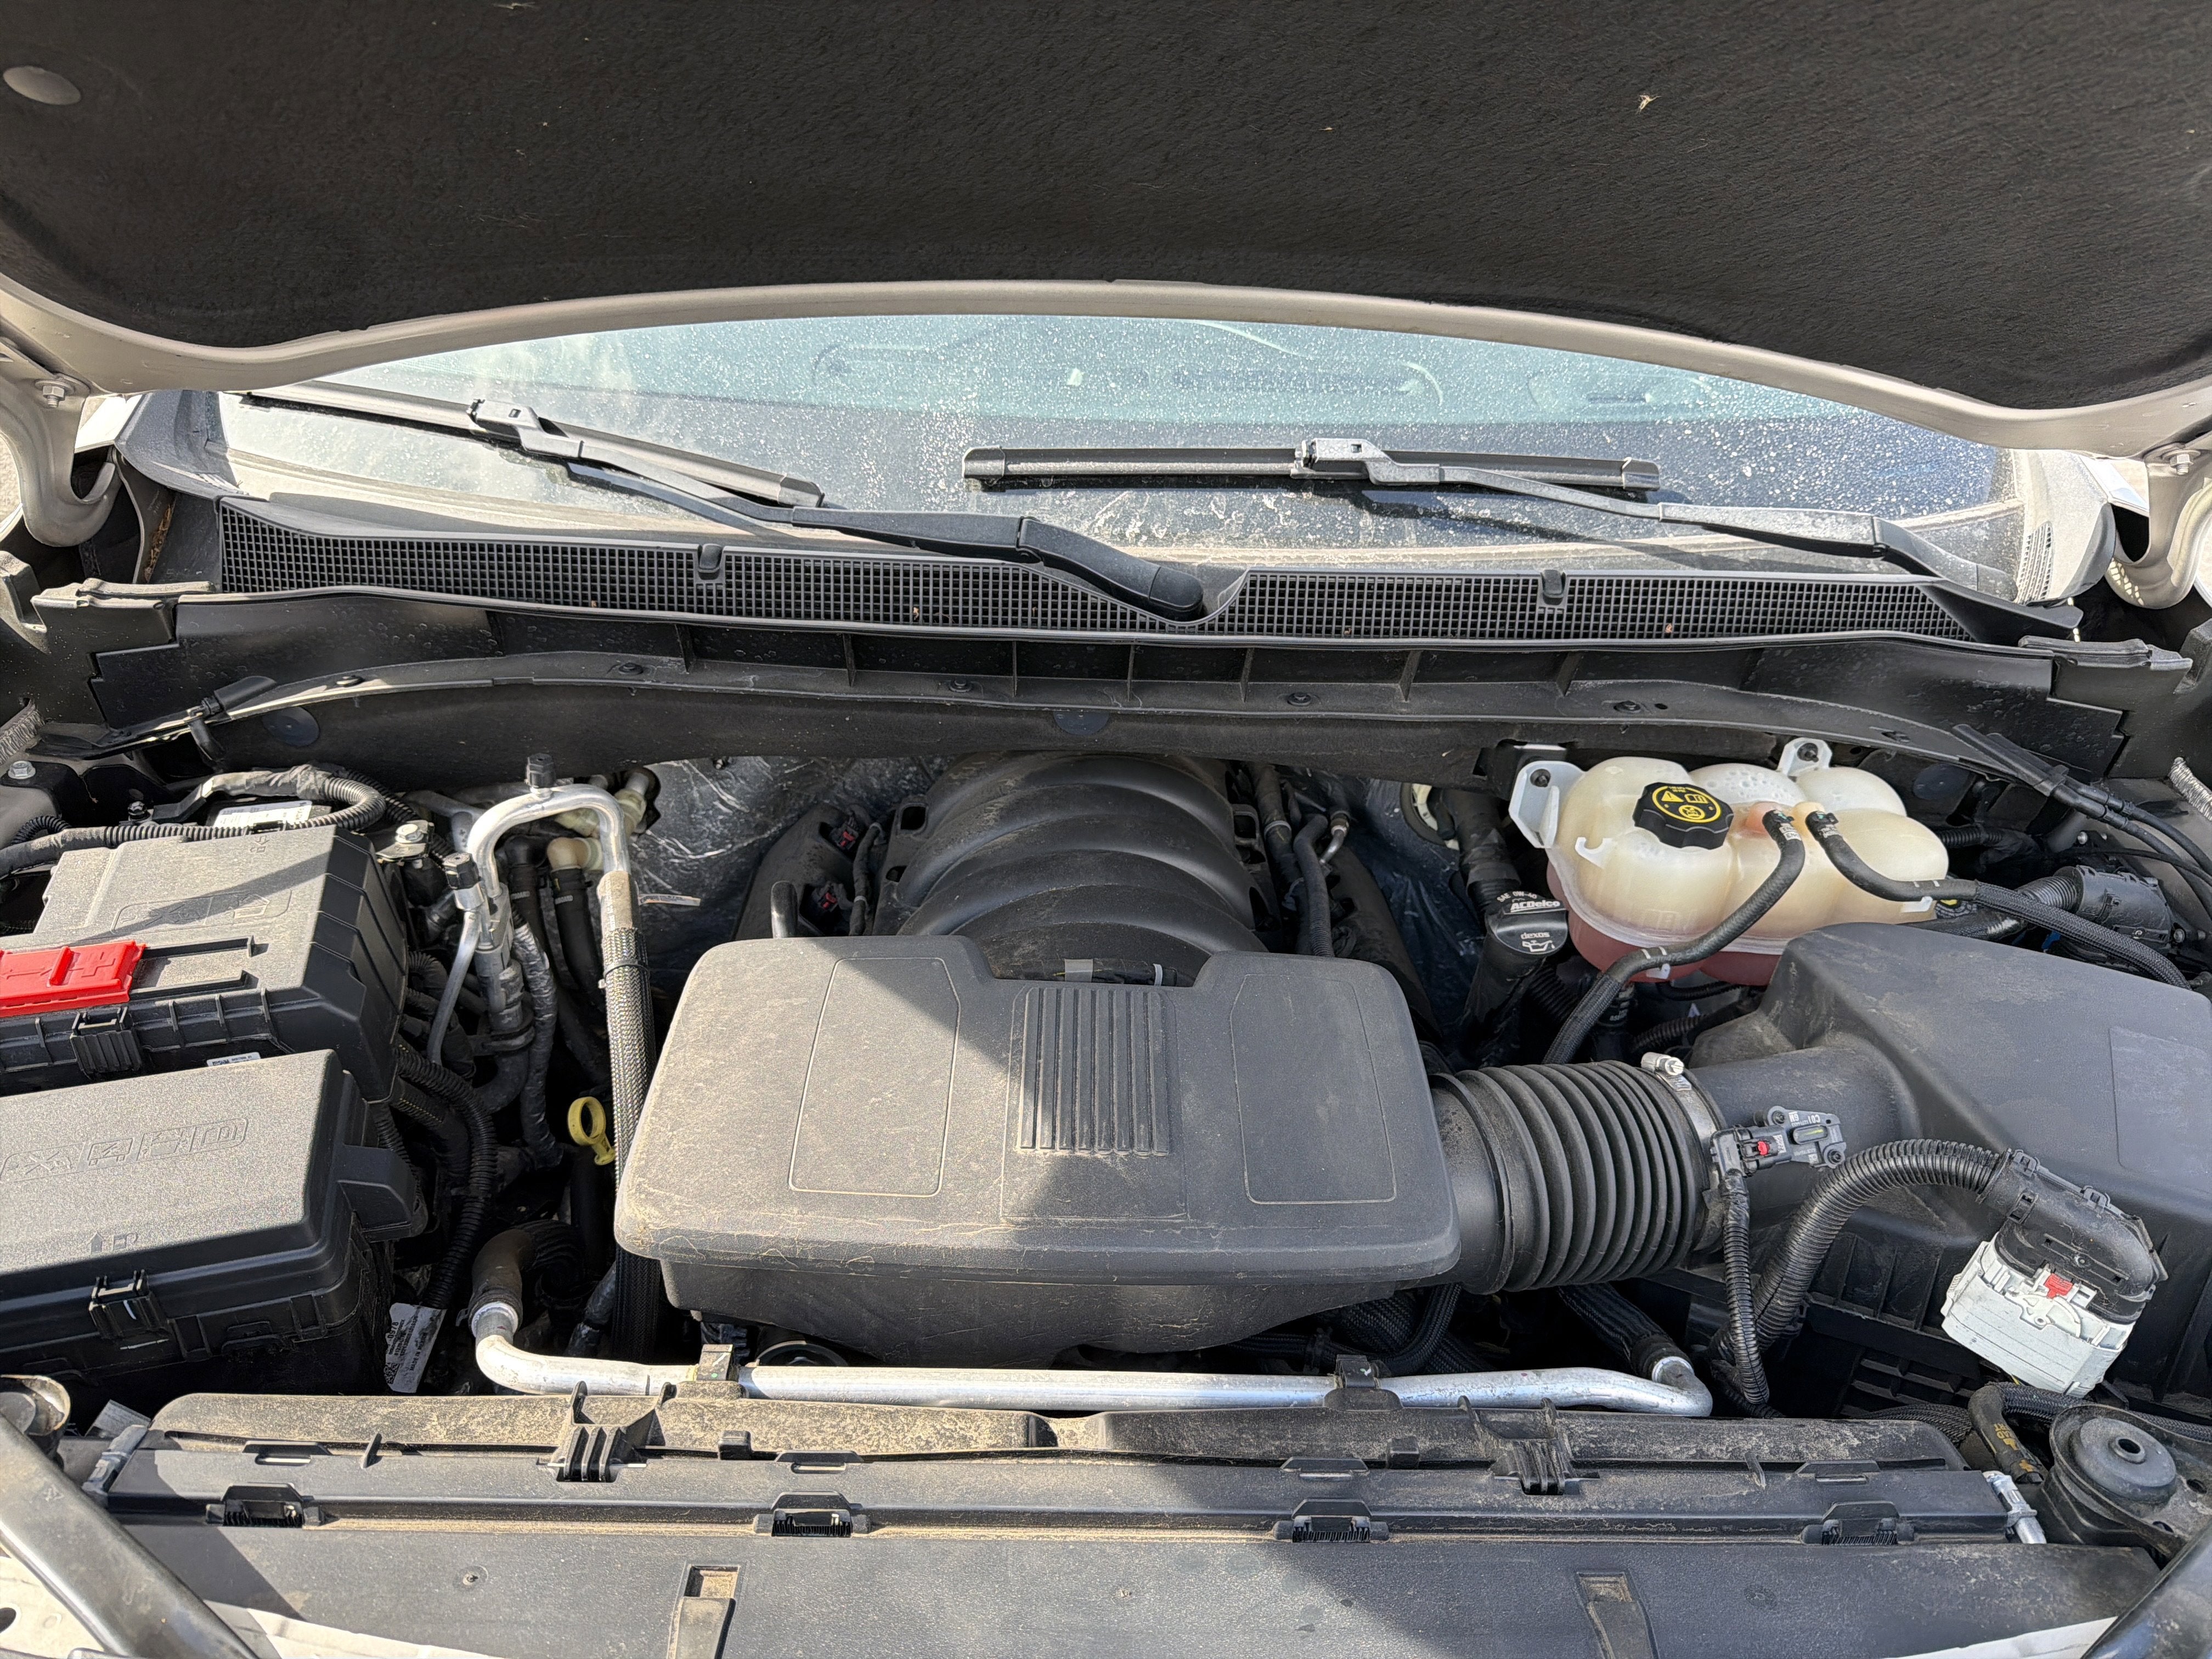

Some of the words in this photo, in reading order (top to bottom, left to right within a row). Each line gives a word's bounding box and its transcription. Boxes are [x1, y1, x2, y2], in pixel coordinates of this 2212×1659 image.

[1497, 893, 1511, 902] SAE
[1510, 900, 1561, 911] ACDelco
[1520, 932, 1550, 940] dexos
[409, 1357, 419, 1371] MADE
